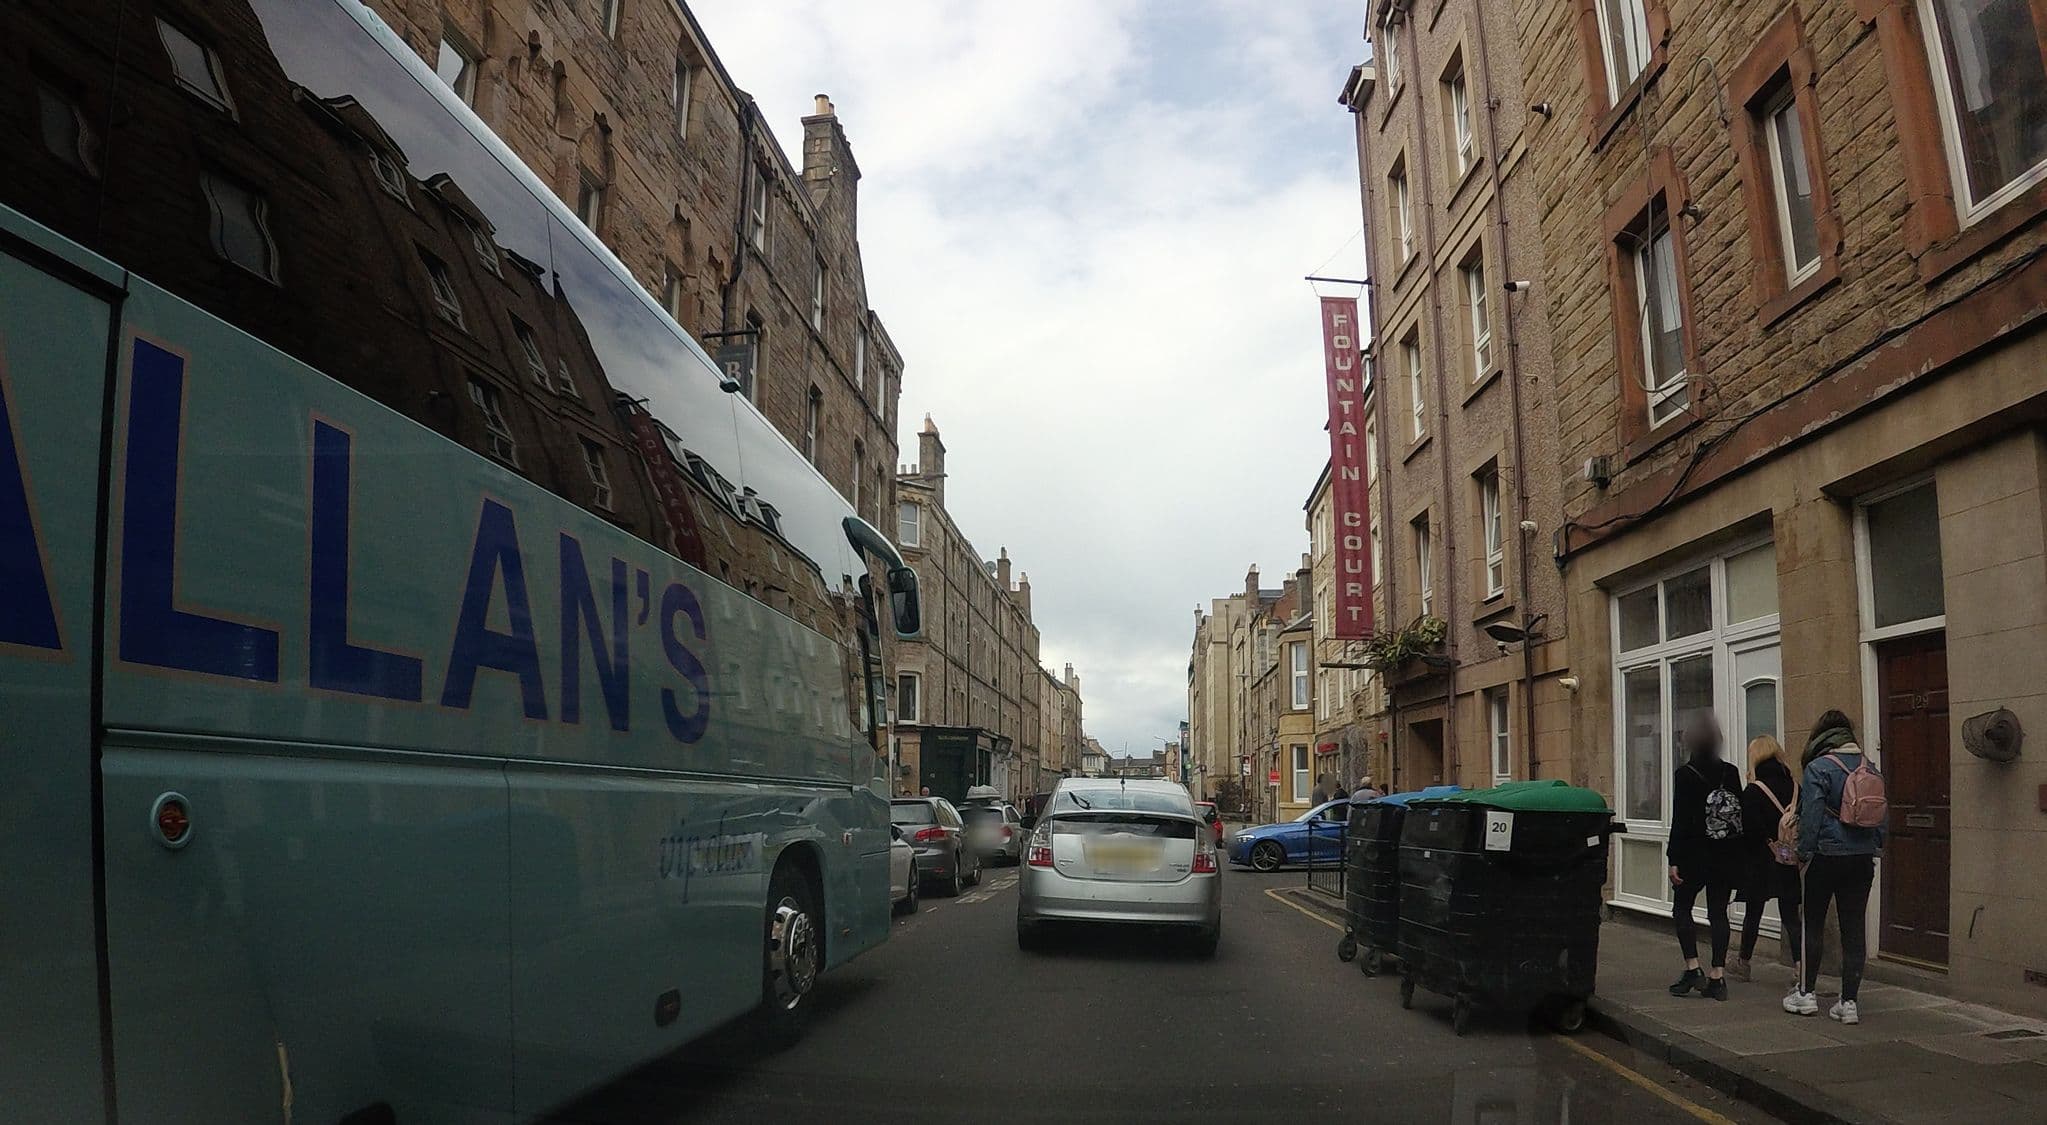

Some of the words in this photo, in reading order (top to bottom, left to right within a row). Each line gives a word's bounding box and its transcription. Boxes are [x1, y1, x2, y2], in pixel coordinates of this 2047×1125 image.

[1333, 313, 1360, 481] FOUNTAIN
[1342, 511, 1363, 622] COURT
[1491, 821, 1507, 833] 20
